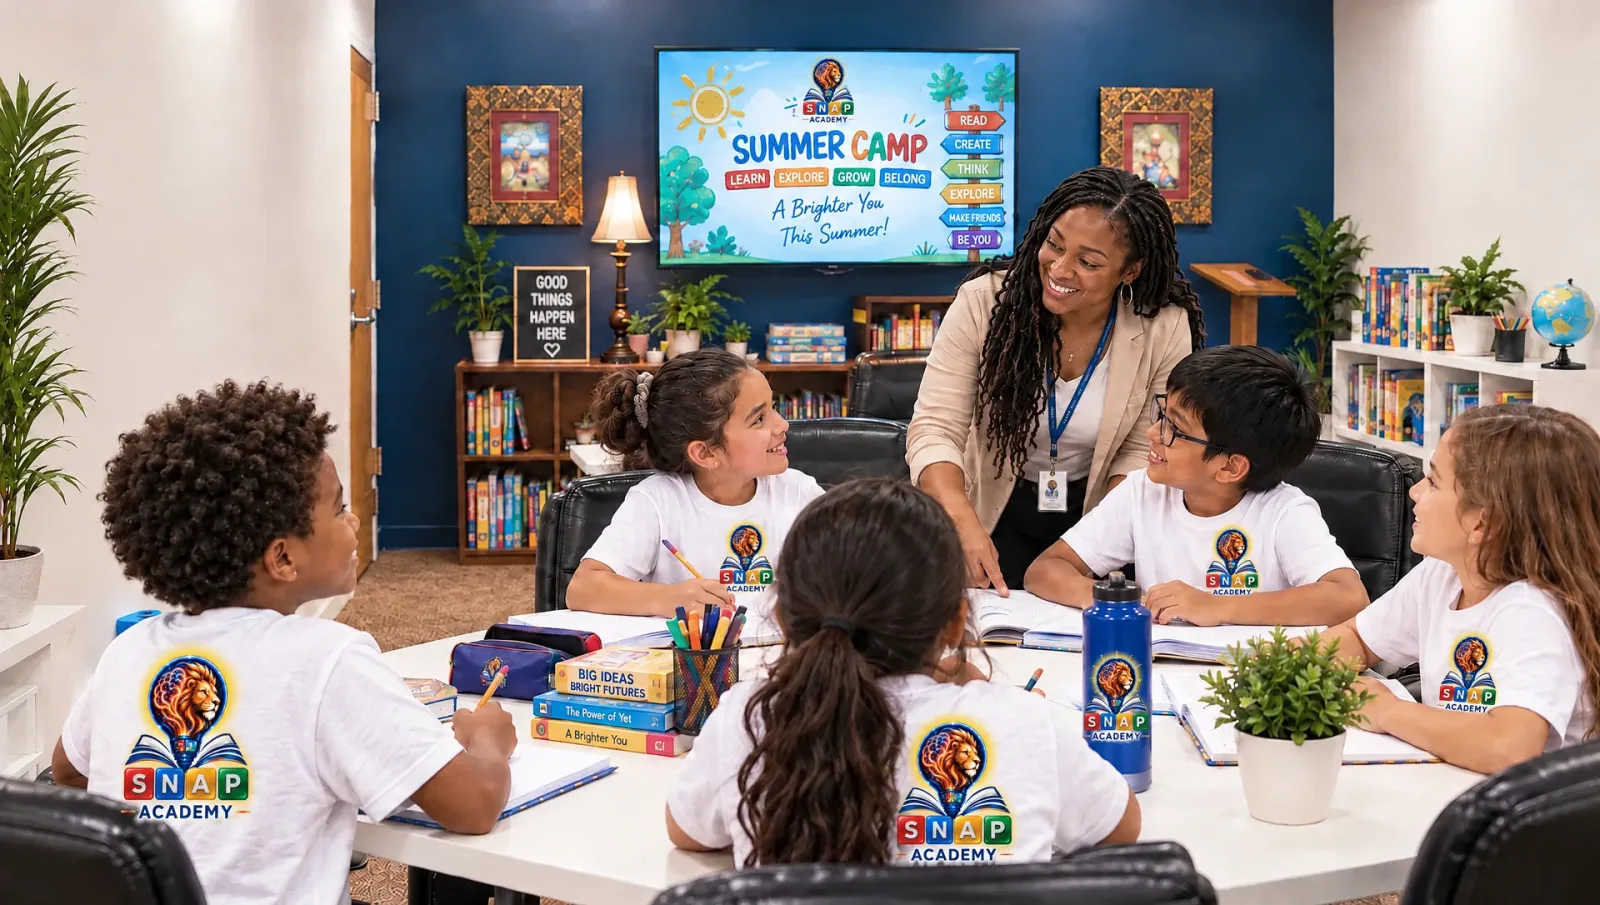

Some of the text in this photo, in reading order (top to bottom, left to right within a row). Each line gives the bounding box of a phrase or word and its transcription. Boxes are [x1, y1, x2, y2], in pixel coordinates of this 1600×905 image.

[806, 103, 851, 113] SNAP
[960, 114, 988, 126] READ
[732, 130, 928, 165] SUMMER CAMP
[954, 139, 992, 150] CREATE
[957, 163, 989, 175] THINK
[730, 172, 766, 186] LEARN
[778, 170, 825, 184] EXPLORE
[837, 171, 871, 183] GROW
[884, 171, 926, 184] BELONG
[950, 188, 995, 200] EXPLORE
[771, 191, 885, 223] A Brighter You
[949, 213, 1001, 223] MAKE FRIENDS
[780, 216, 890, 247] This Summer!
[957, 234, 991, 245] BE YOU
[536, 274, 568, 290] GOOD
[530, 292, 573, 307] THINGS
[529, 310, 575, 324] HAPPEN
[536, 326, 567, 341] HERE
[723, 572, 770, 582] SNAP
[1209, 576, 1255, 586] SNAP
[578, 668, 634, 685] BIG IDEAS
[570, 681, 646, 699] BRIGHT FUTURES
[1442, 688, 1493, 702] SNAP
[565, 705, 632, 724] The Power of Yet
[1445, 703, 1488, 713] ACADEMY
[1087, 716, 1145, 728] SNAP
[565, 728, 628, 746] A Brighter You
[1092, 732, 1141, 740] ACADEMY
[131, 773, 241, 794] SNAP
[138, 804, 233, 819] ACADEMY
[903, 820, 1006, 839] SNAP
[910, 848, 997, 861] ACADEMY
